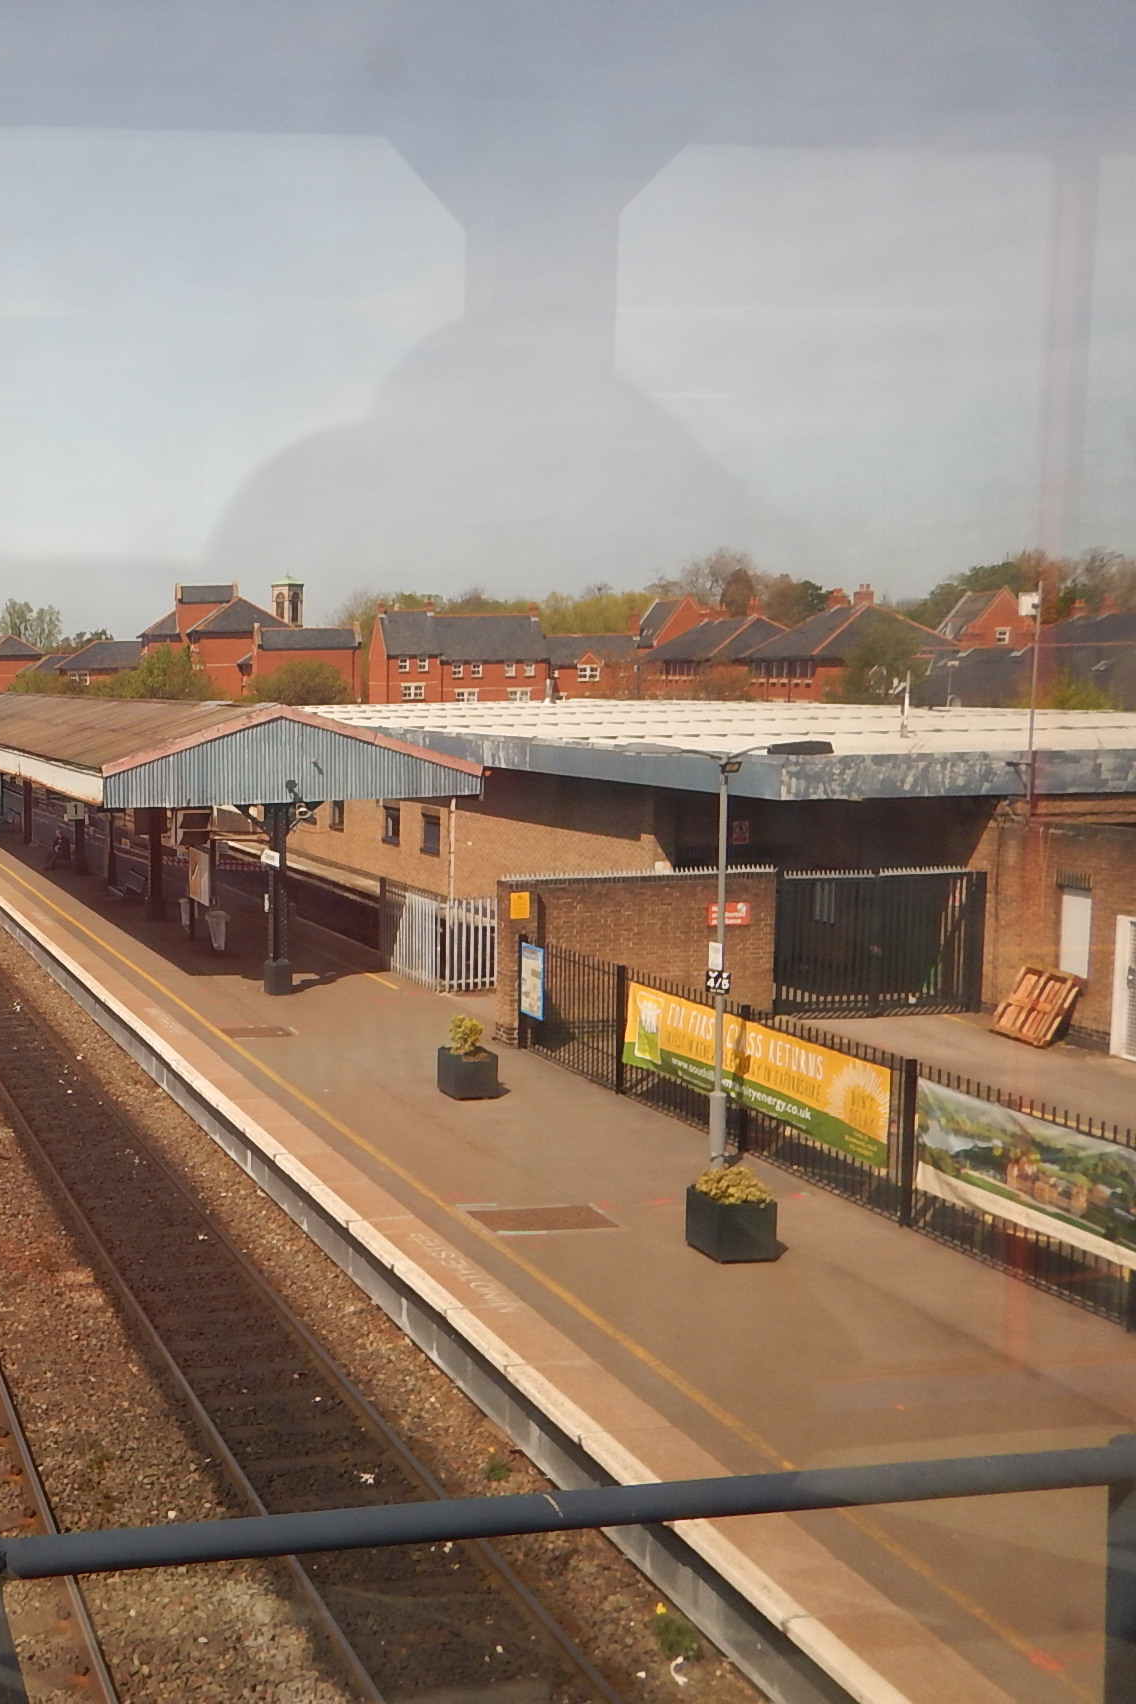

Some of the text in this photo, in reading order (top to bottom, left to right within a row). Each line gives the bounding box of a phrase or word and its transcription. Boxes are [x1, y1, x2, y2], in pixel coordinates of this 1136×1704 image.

[667, 1003, 685, 1030] FOR
[688, 1011, 716, 1041] FIRS
[768, 1038, 826, 1080] RETURNS
[687, 1037, 694, 1053] IN
[764, 1065, 771, 1082] IN
[775, 1069, 822, 1102] OXFORDSHIRE
[470, 1282, 521, 1313] MIND
